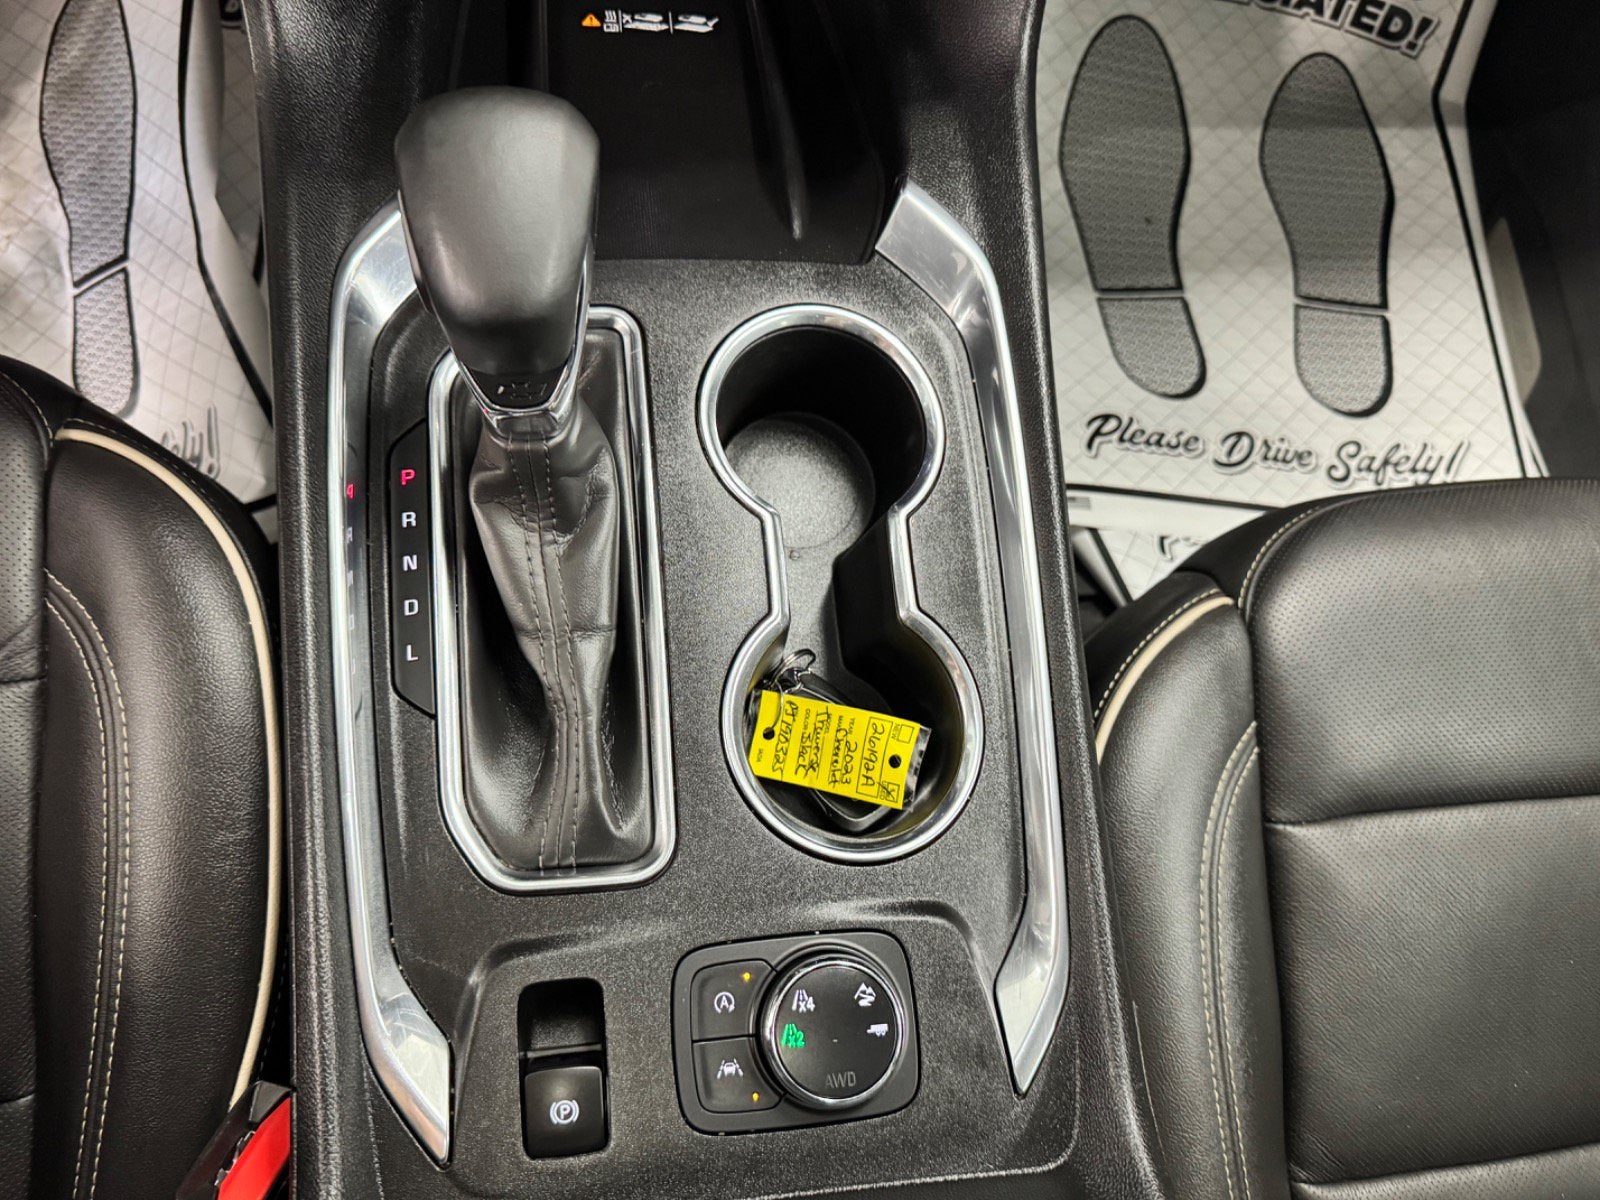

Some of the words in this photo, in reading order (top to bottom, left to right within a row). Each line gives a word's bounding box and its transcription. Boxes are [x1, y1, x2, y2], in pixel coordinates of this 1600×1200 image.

[1258, 0, 1434, 50] ATED!
[1086, 413, 1201, 451] Please
[1213, 431, 1313, 468] Drive
[1327, 440, 1466, 487] Safely!
[401, 469, 416, 485] P
[401, 512, 417, 528] R
[403, 555, 418, 571] N
[404, 599, 419, 616] D
[406, 645, 419, 661] L
[841, 741, 858, 784] 2023
[825, 1071, 856, 1089] AWD
